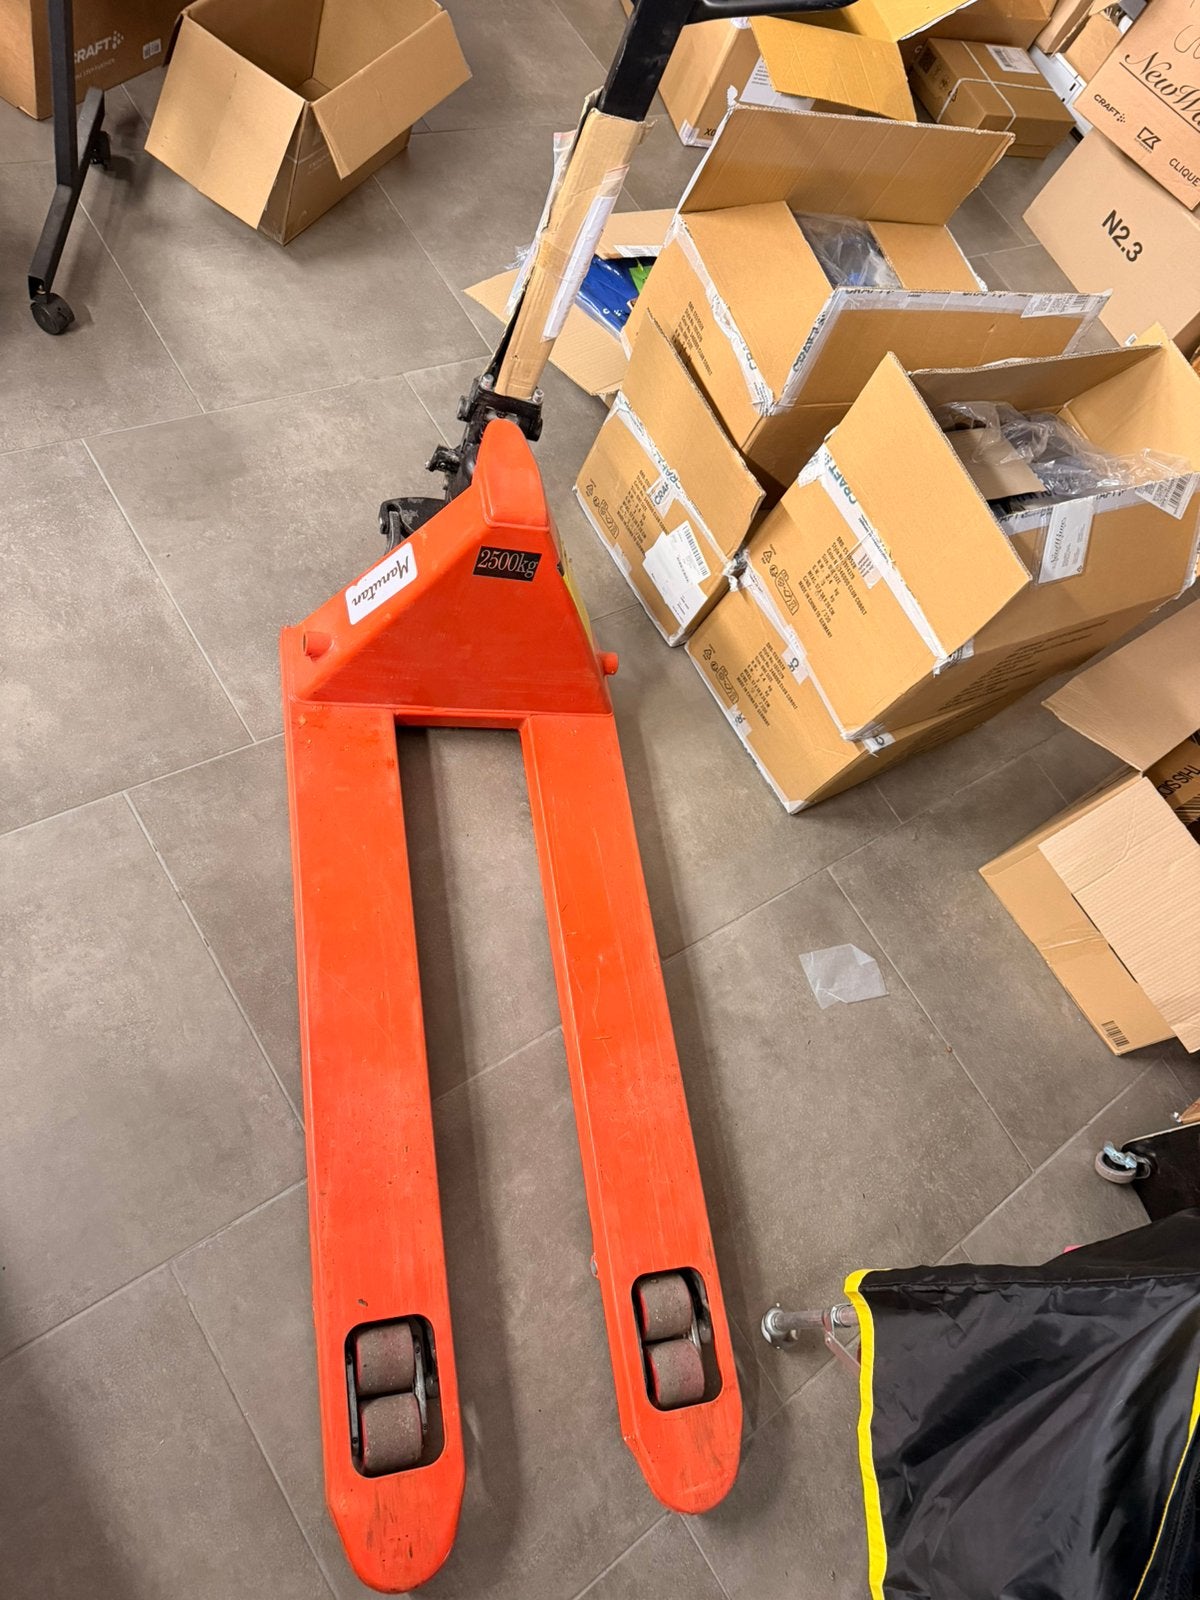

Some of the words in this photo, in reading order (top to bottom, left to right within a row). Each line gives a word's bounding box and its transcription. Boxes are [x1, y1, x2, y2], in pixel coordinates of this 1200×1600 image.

[74, 36, 112, 63] RAFT
[1094, 93, 1121, 118] CRAFT
[1168, 157, 1200, 187] CLIQUE
[1102, 209, 1143, 262] N2.3
[477, 549, 538, 578] 2500kg
[352, 556, 410, 607] Manutan
